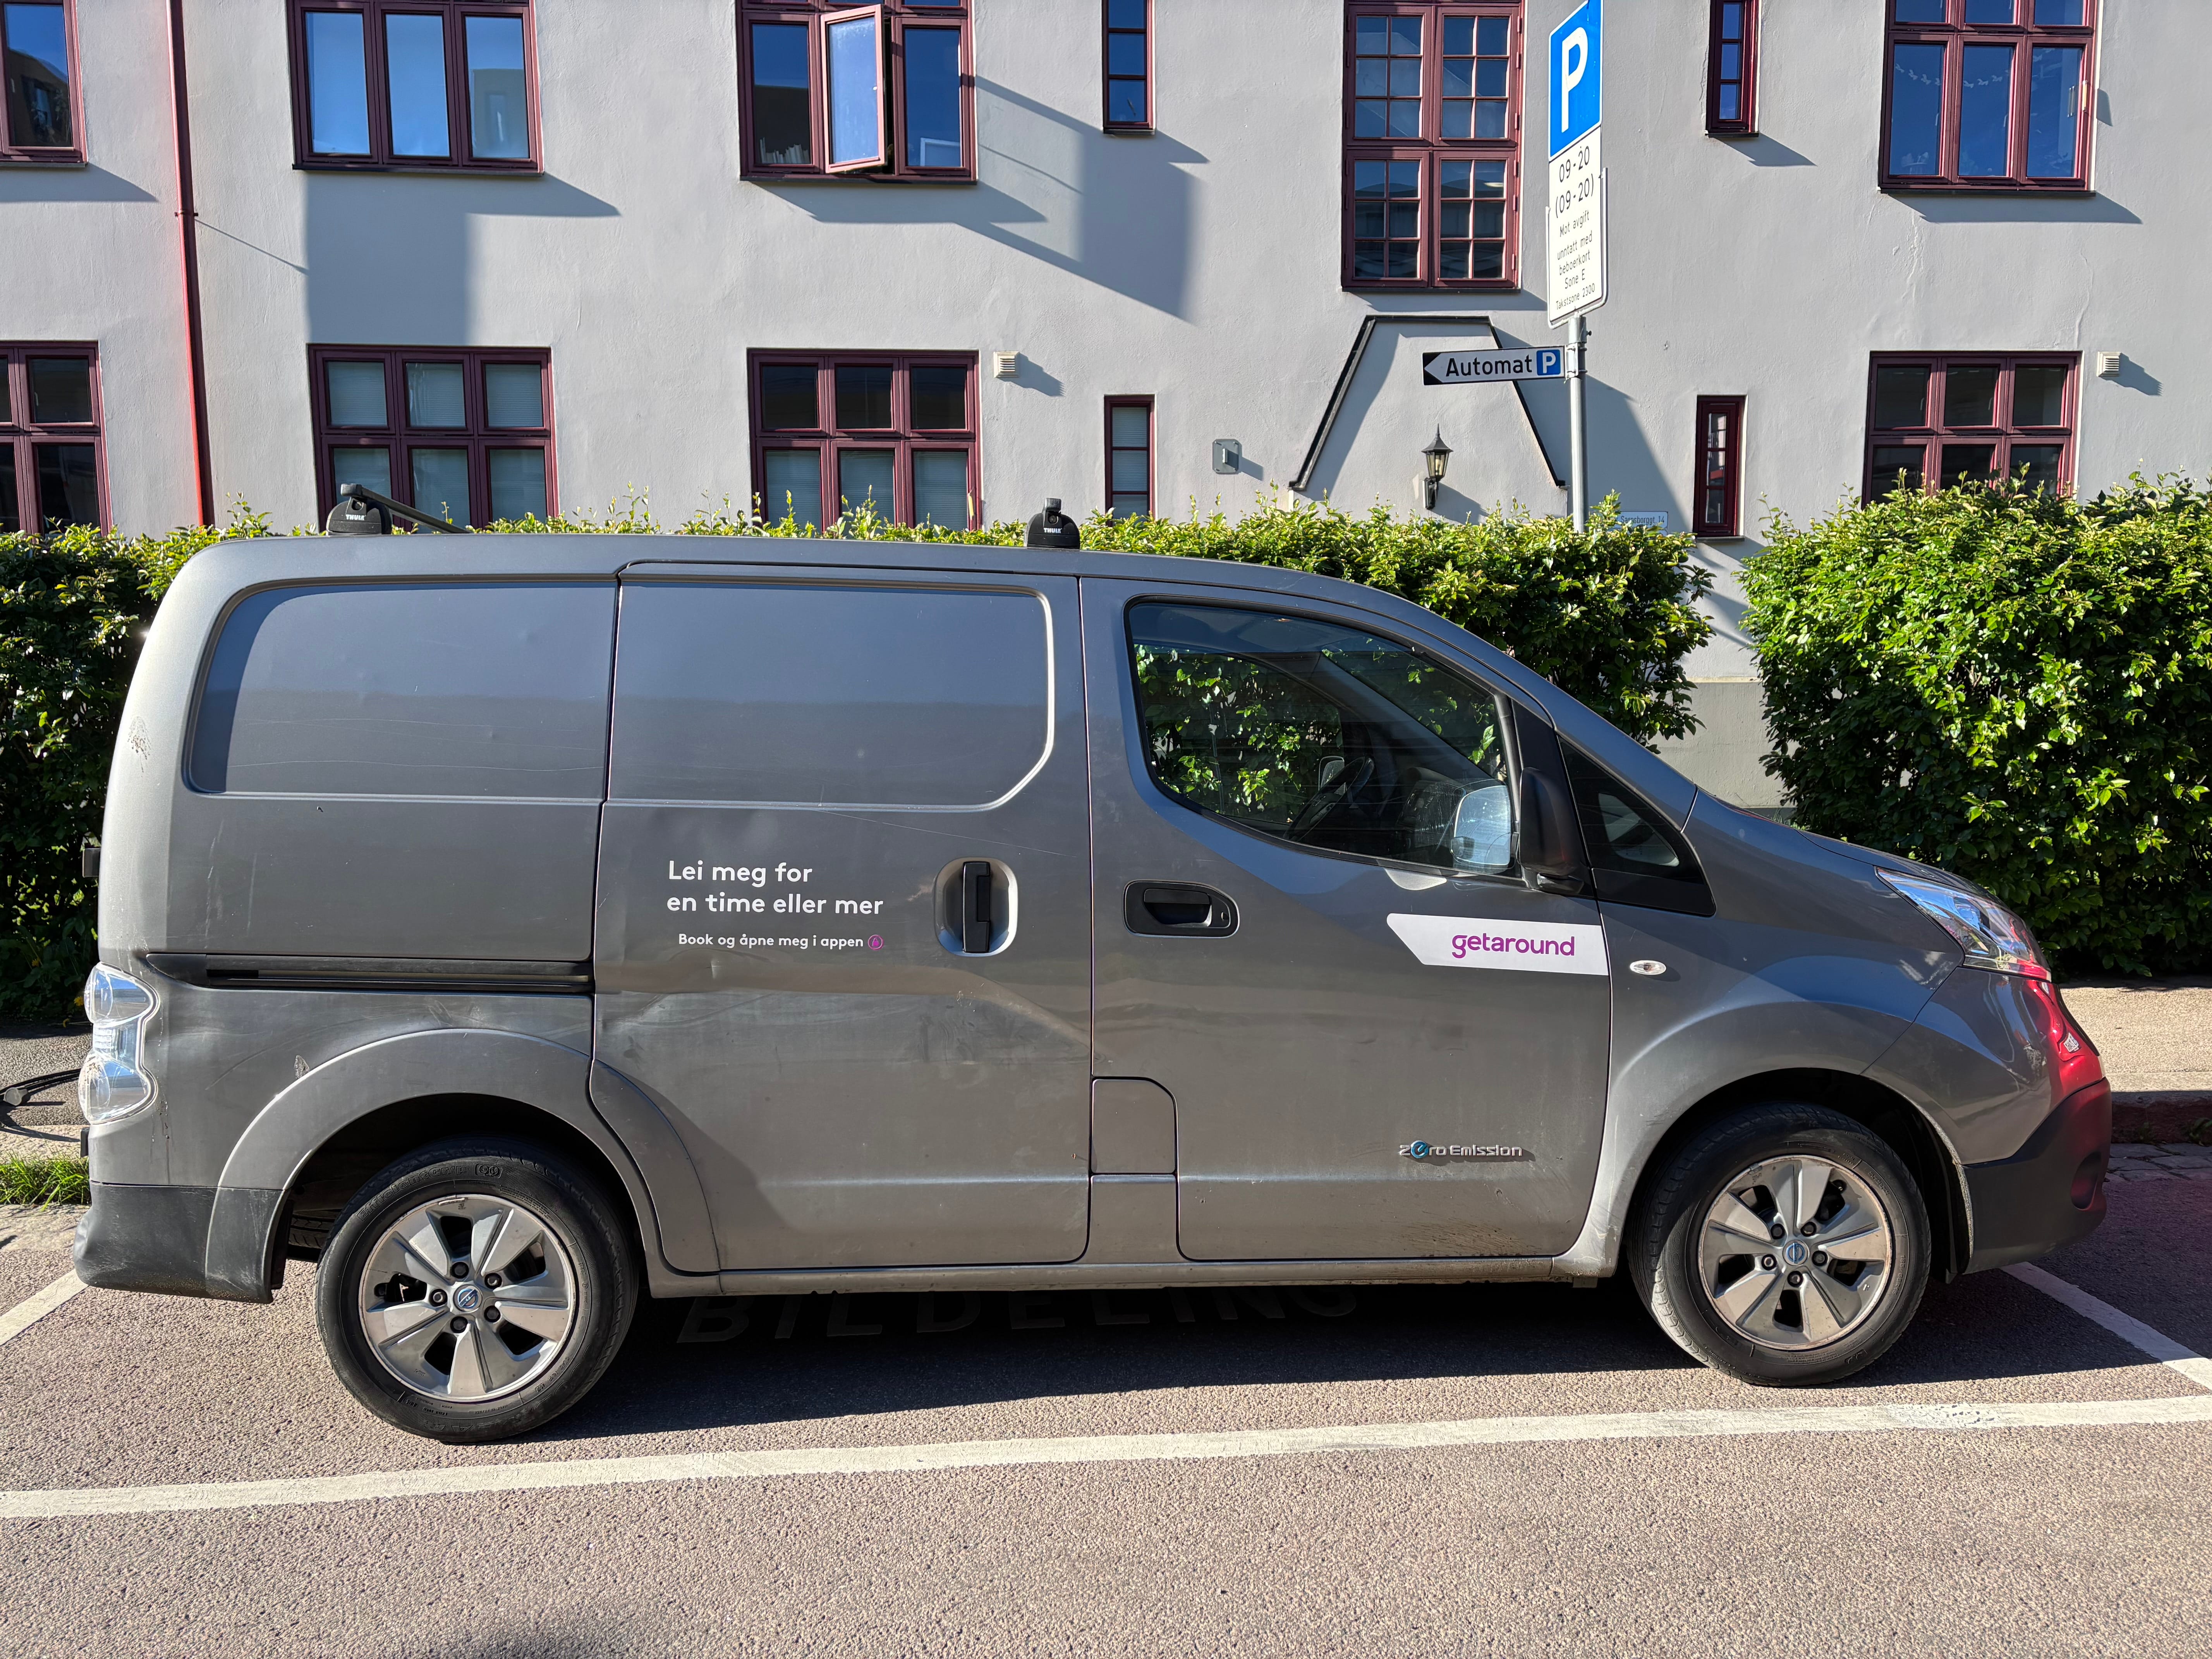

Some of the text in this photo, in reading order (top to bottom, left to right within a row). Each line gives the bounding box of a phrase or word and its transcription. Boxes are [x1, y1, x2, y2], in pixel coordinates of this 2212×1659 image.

[1561, 27, 1588, 133] P
[1559, 146, 1590, 183] 09-20
[1555, 173, 1594, 218] (09-20)
[1560, 209, 1589, 237] Mot avgift
[1558, 230, 1592, 260] unntatt med
[1559, 249, 1590, 276] beboerkort
[1565, 268, 1585, 289] Sone E
[1556, 283, 1595, 310] Takstsone 2300
[1446, 352, 1556, 377] Automat P
[669, 860, 813, 888] Lei meg for
[666, 891, 884, 914] en time eller mer
[678, 933, 864, 950] Book og åpne meg i appen
[1451, 933, 1575, 959] getaround
